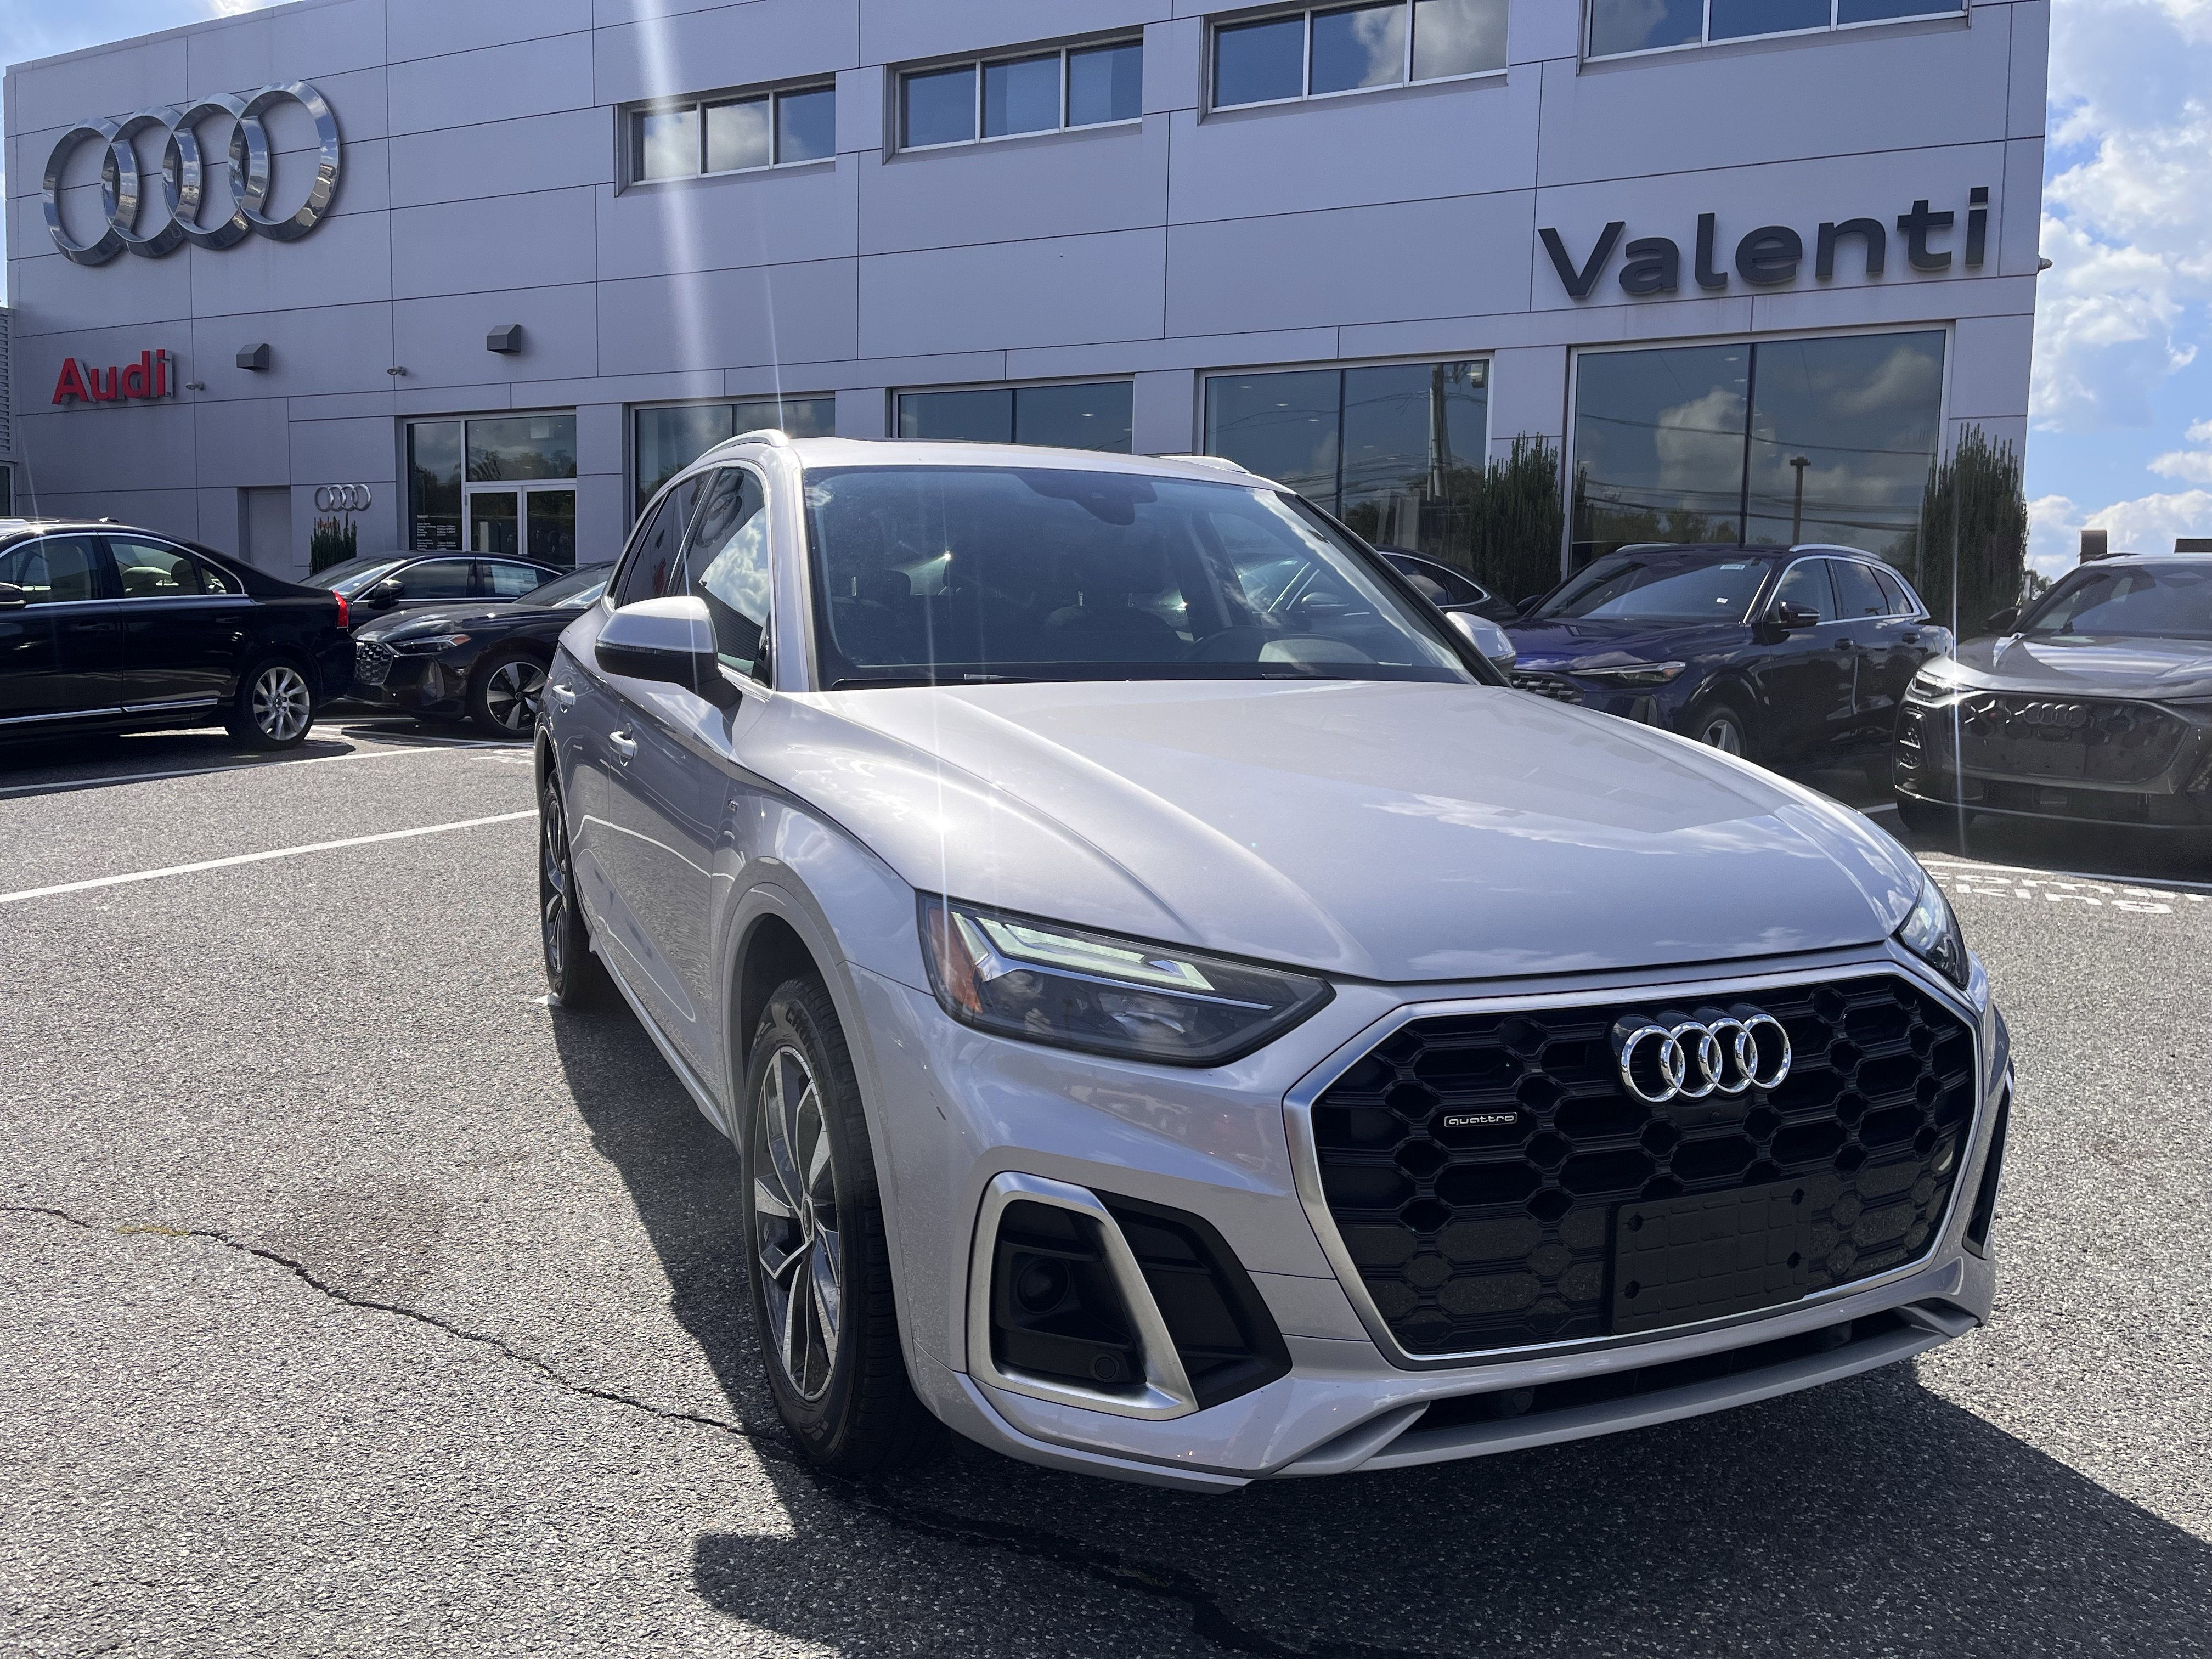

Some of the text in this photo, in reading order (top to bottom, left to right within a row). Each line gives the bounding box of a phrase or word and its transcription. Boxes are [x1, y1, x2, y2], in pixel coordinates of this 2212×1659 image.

[1538, 186, 1989, 298] Valenti
[52, 349, 167, 404] Audi
[1938, 883, 2172, 914] king
[1448, 1115, 1514, 1125] quattro
